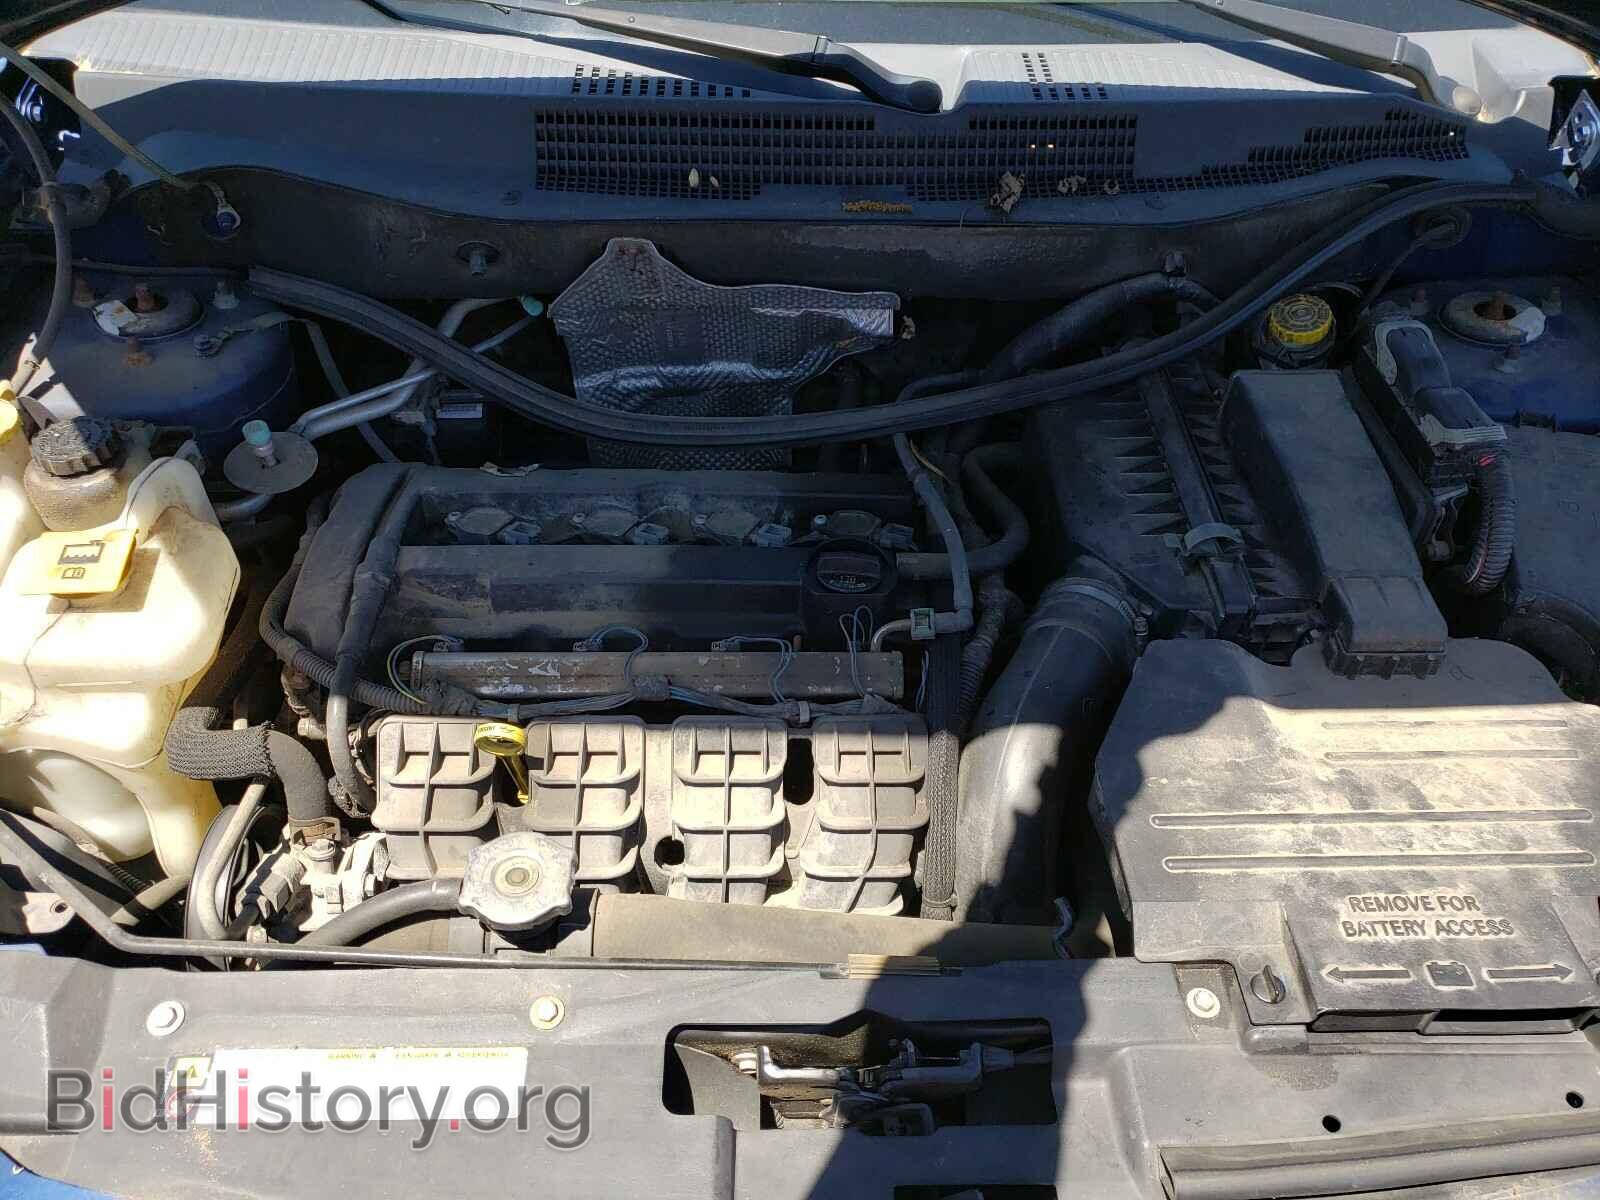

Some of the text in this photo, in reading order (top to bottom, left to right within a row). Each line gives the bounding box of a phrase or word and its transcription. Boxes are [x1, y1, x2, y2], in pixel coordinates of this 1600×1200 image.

[1348, 895, 1482, 913] REMOVE FOR
[1341, 918, 1515, 938] BATTERY ACCESS
